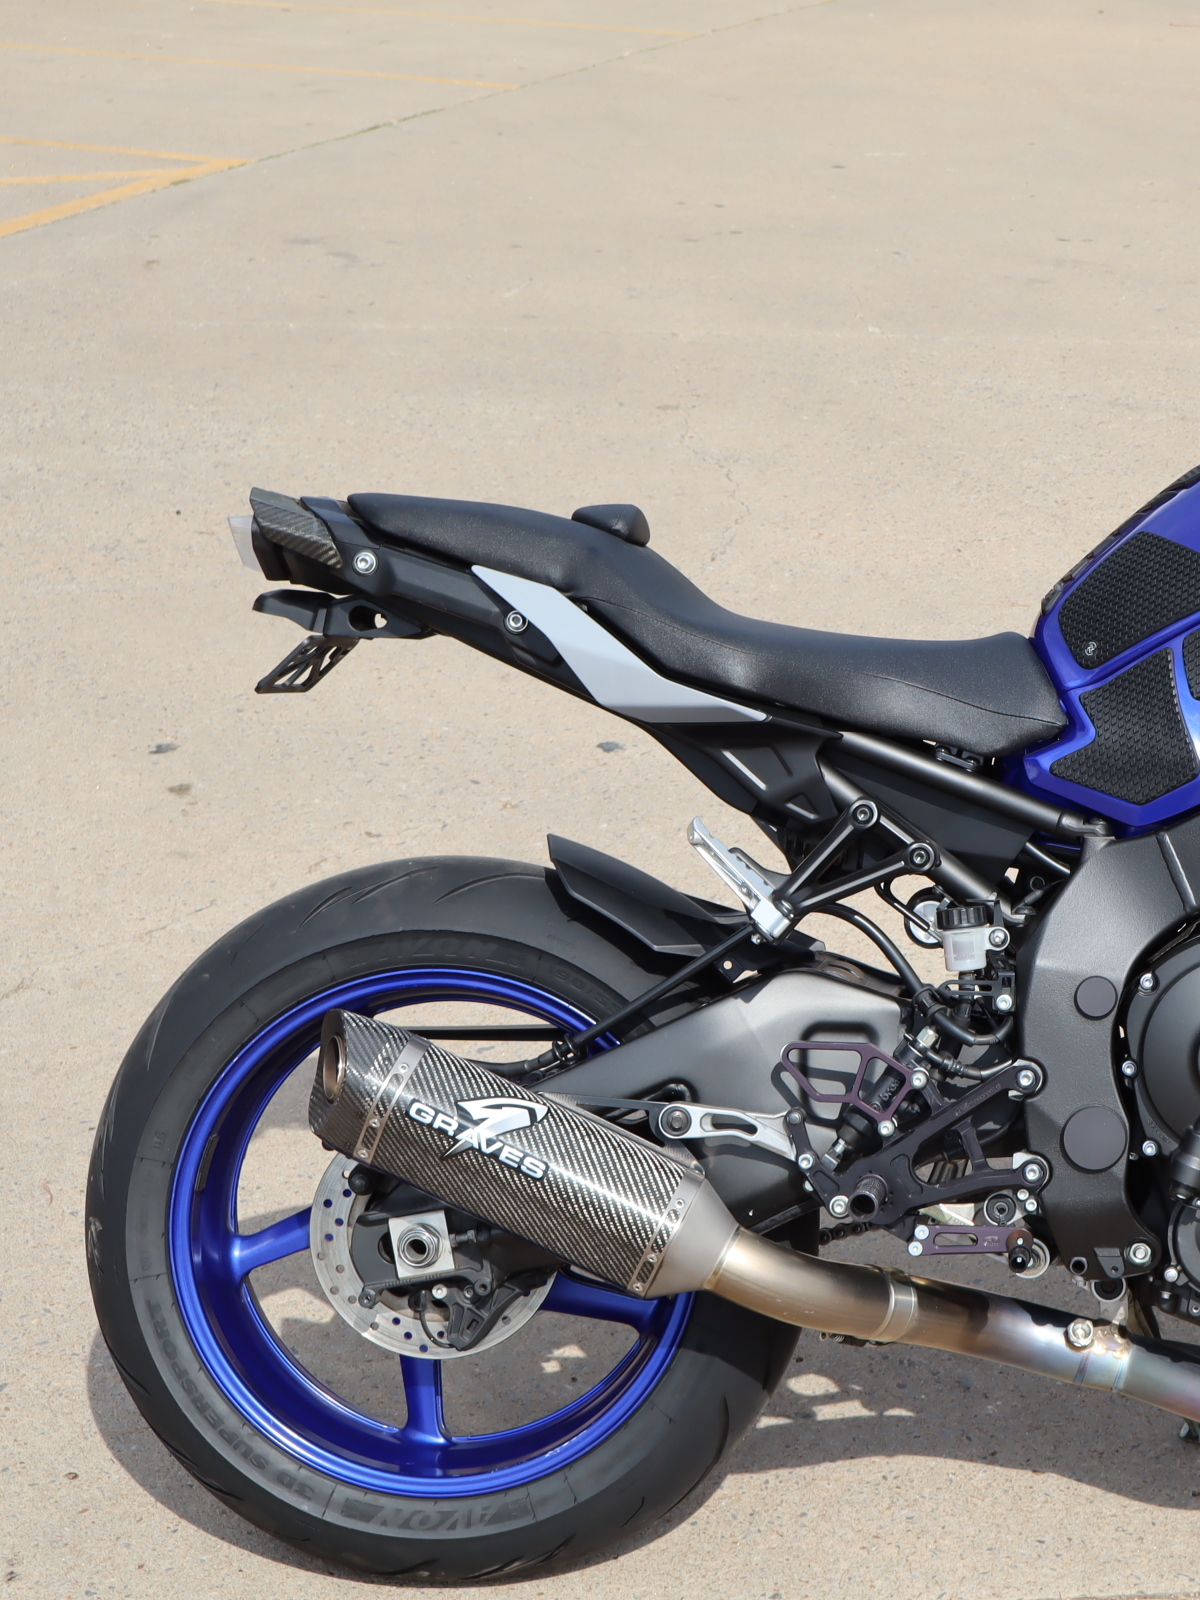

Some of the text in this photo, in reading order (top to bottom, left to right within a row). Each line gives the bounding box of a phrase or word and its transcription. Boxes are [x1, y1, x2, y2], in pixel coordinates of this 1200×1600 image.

[410, 1102, 546, 1179] GRAVES
[144, 1297, 316, 1501] 3D SUPERSPORT
[376, 1502, 502, 1532] AVON
